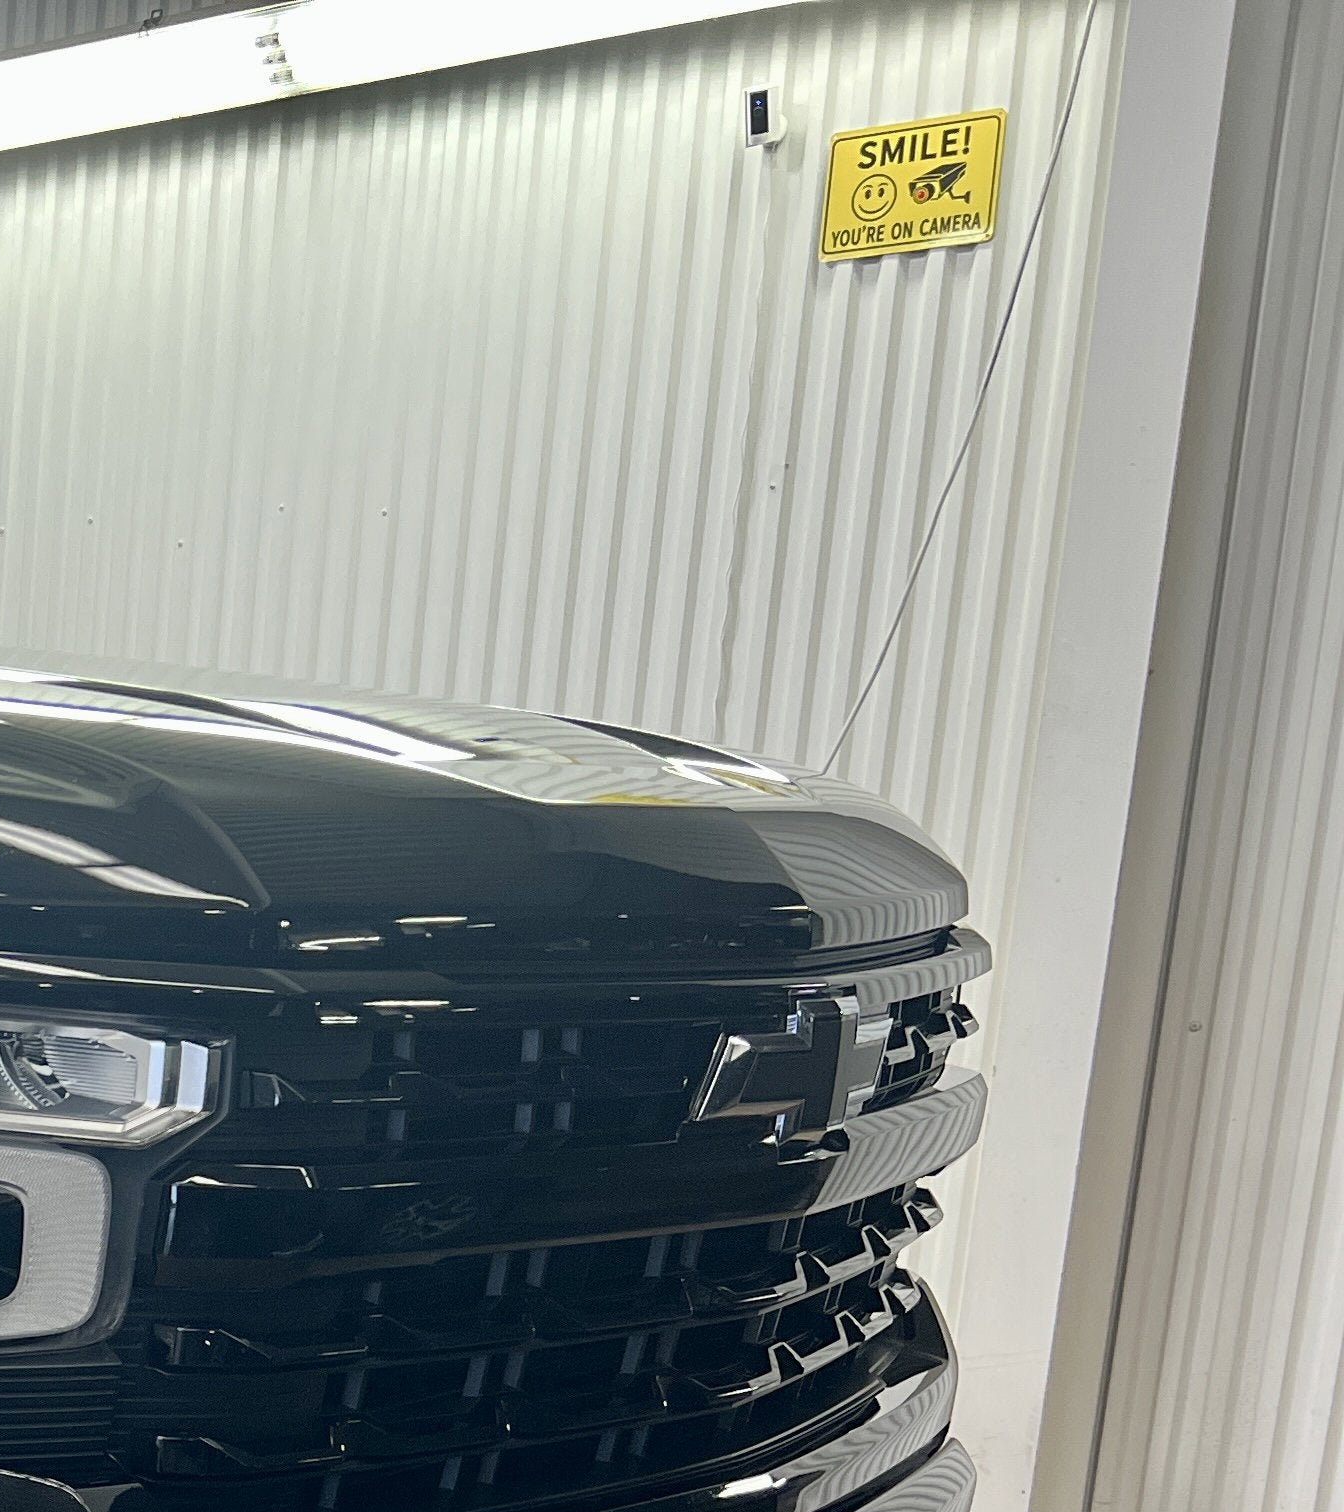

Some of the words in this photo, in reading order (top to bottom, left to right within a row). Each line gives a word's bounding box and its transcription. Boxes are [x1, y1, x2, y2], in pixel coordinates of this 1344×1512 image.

[858, 126, 972, 169] SMILE!
[831, 224, 885, 248] YOU'RE
[891, 220, 913, 240] ON
[919, 212, 981, 236] CAMERA
